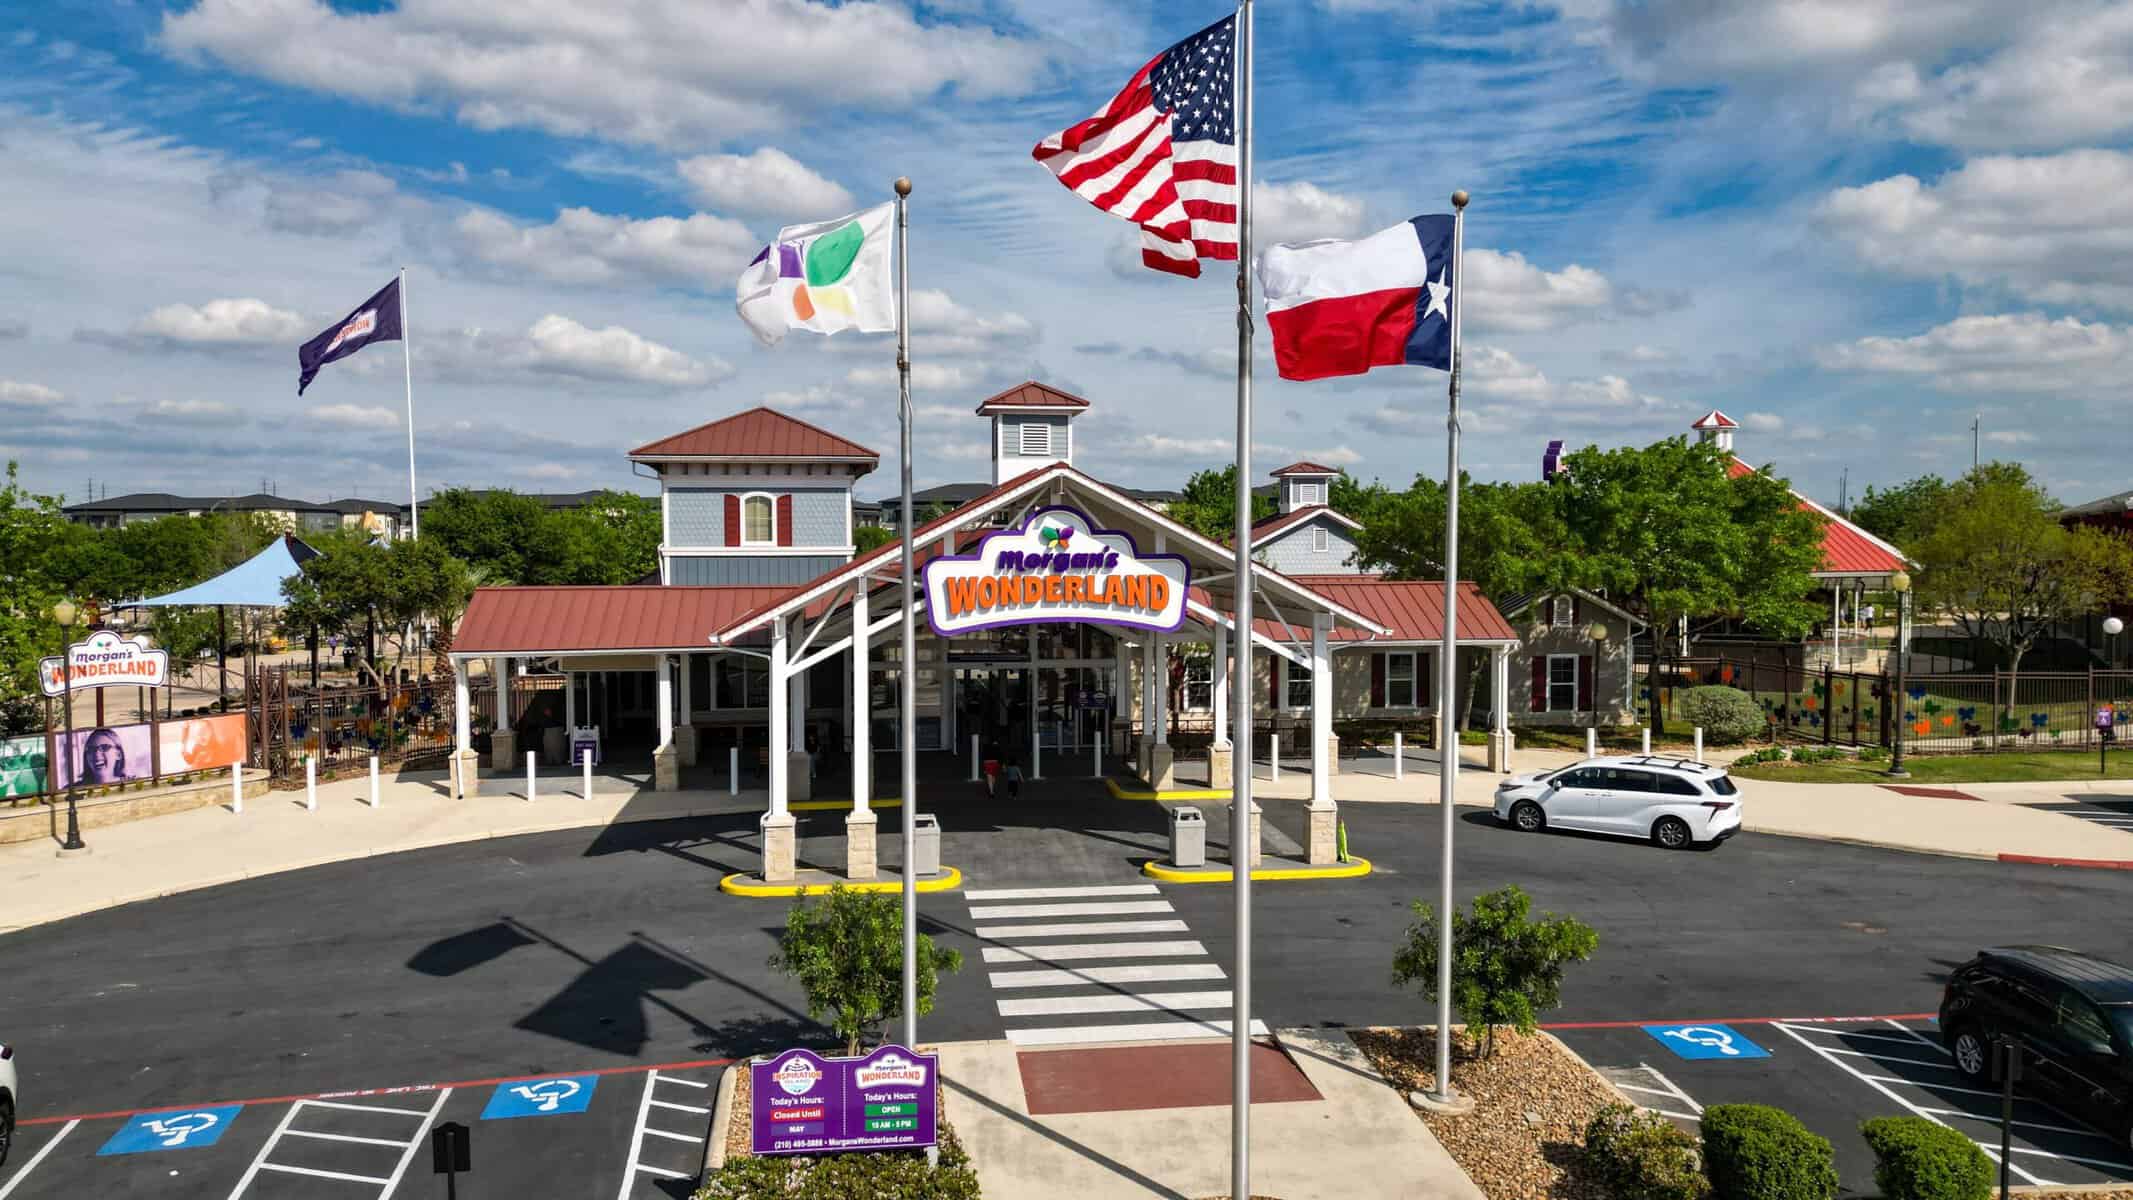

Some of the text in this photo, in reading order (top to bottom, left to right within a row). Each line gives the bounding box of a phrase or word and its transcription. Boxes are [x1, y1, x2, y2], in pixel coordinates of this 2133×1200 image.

[947, 575, 1169, 615] WONDERLAND
[862, 1071, 920, 1083] WONDERLAND
[770, 1097, 798, 1107] Today's
[864, 1093, 892, 1102] Today's
[774, 1109, 821, 1119] Closed Until
[881, 1105, 901, 1113] OPEN
[880, 1121, 891, 1129] AM
